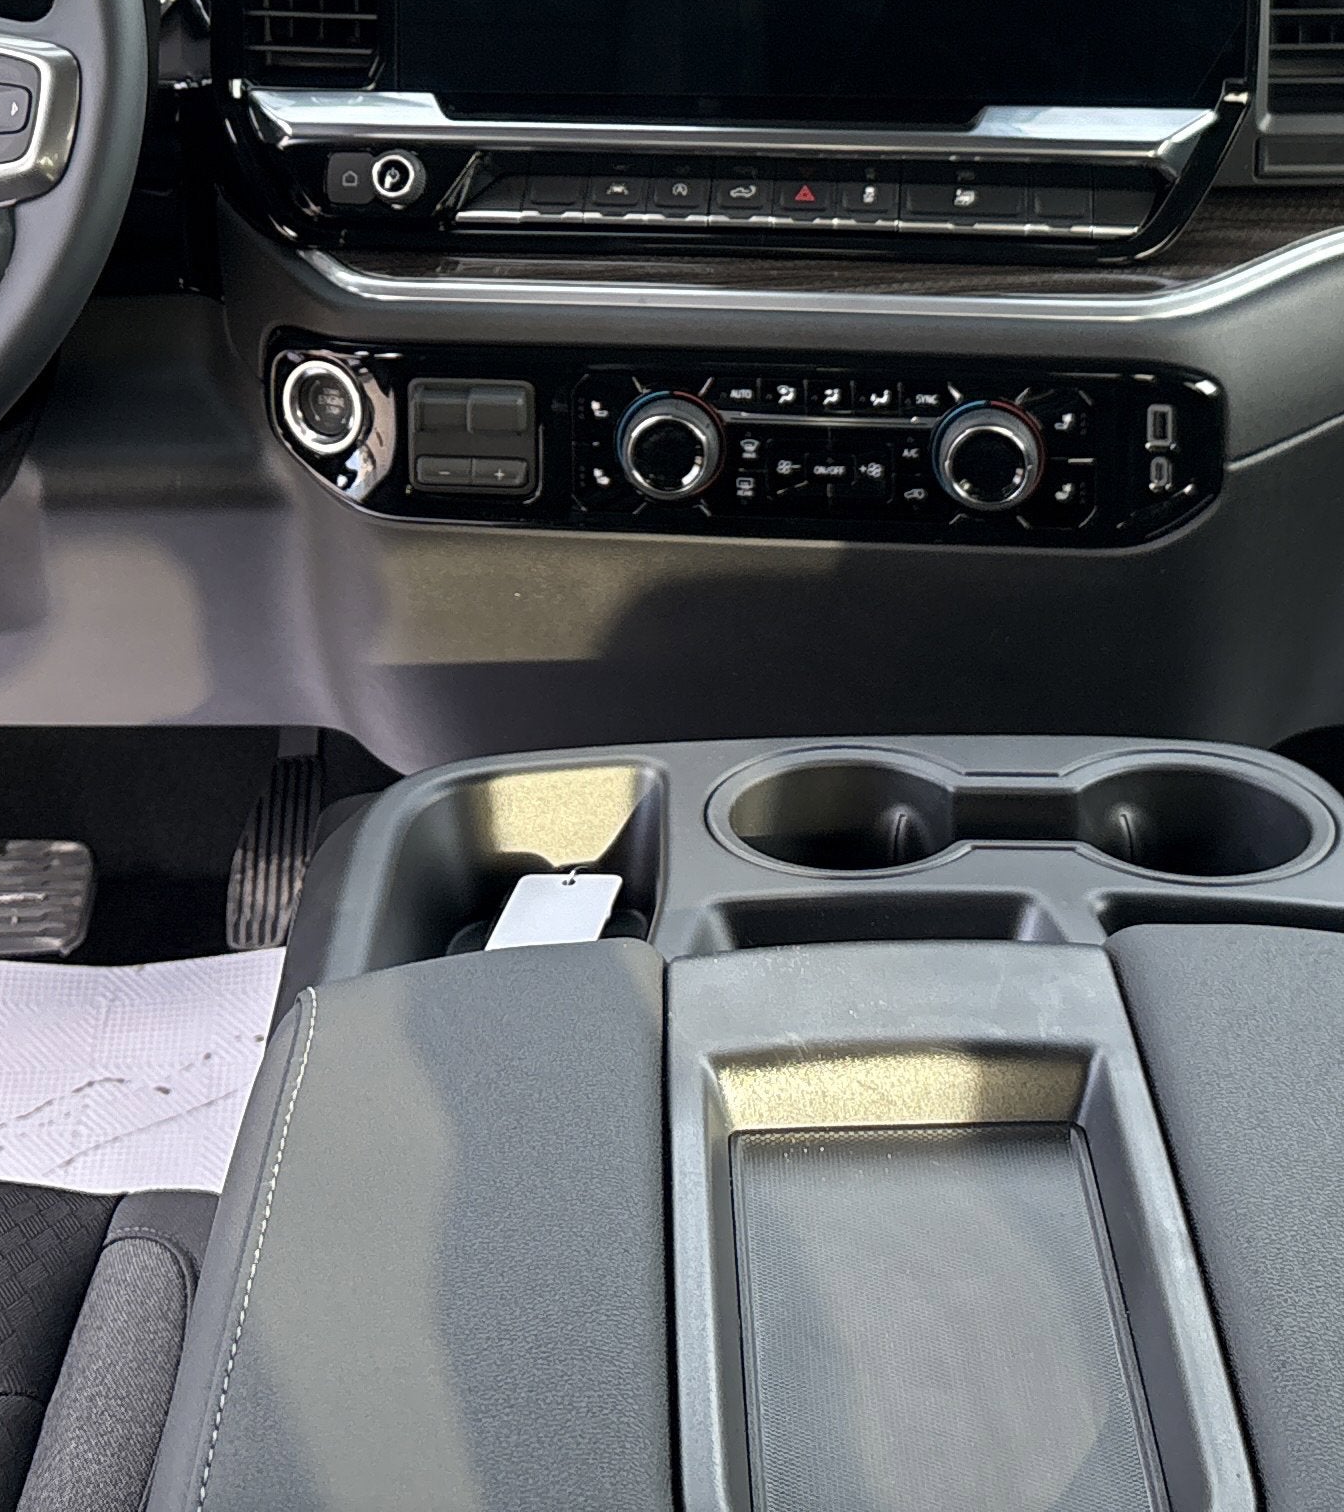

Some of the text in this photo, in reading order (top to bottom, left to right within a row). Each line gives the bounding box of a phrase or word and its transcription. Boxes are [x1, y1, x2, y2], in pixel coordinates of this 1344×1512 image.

[729, 389, 753, 399] AUTO
[915, 394, 940, 405] SYNC
[902, 448, 919, 458] A/C
[813, 465, 847, 476] ON/OFF
